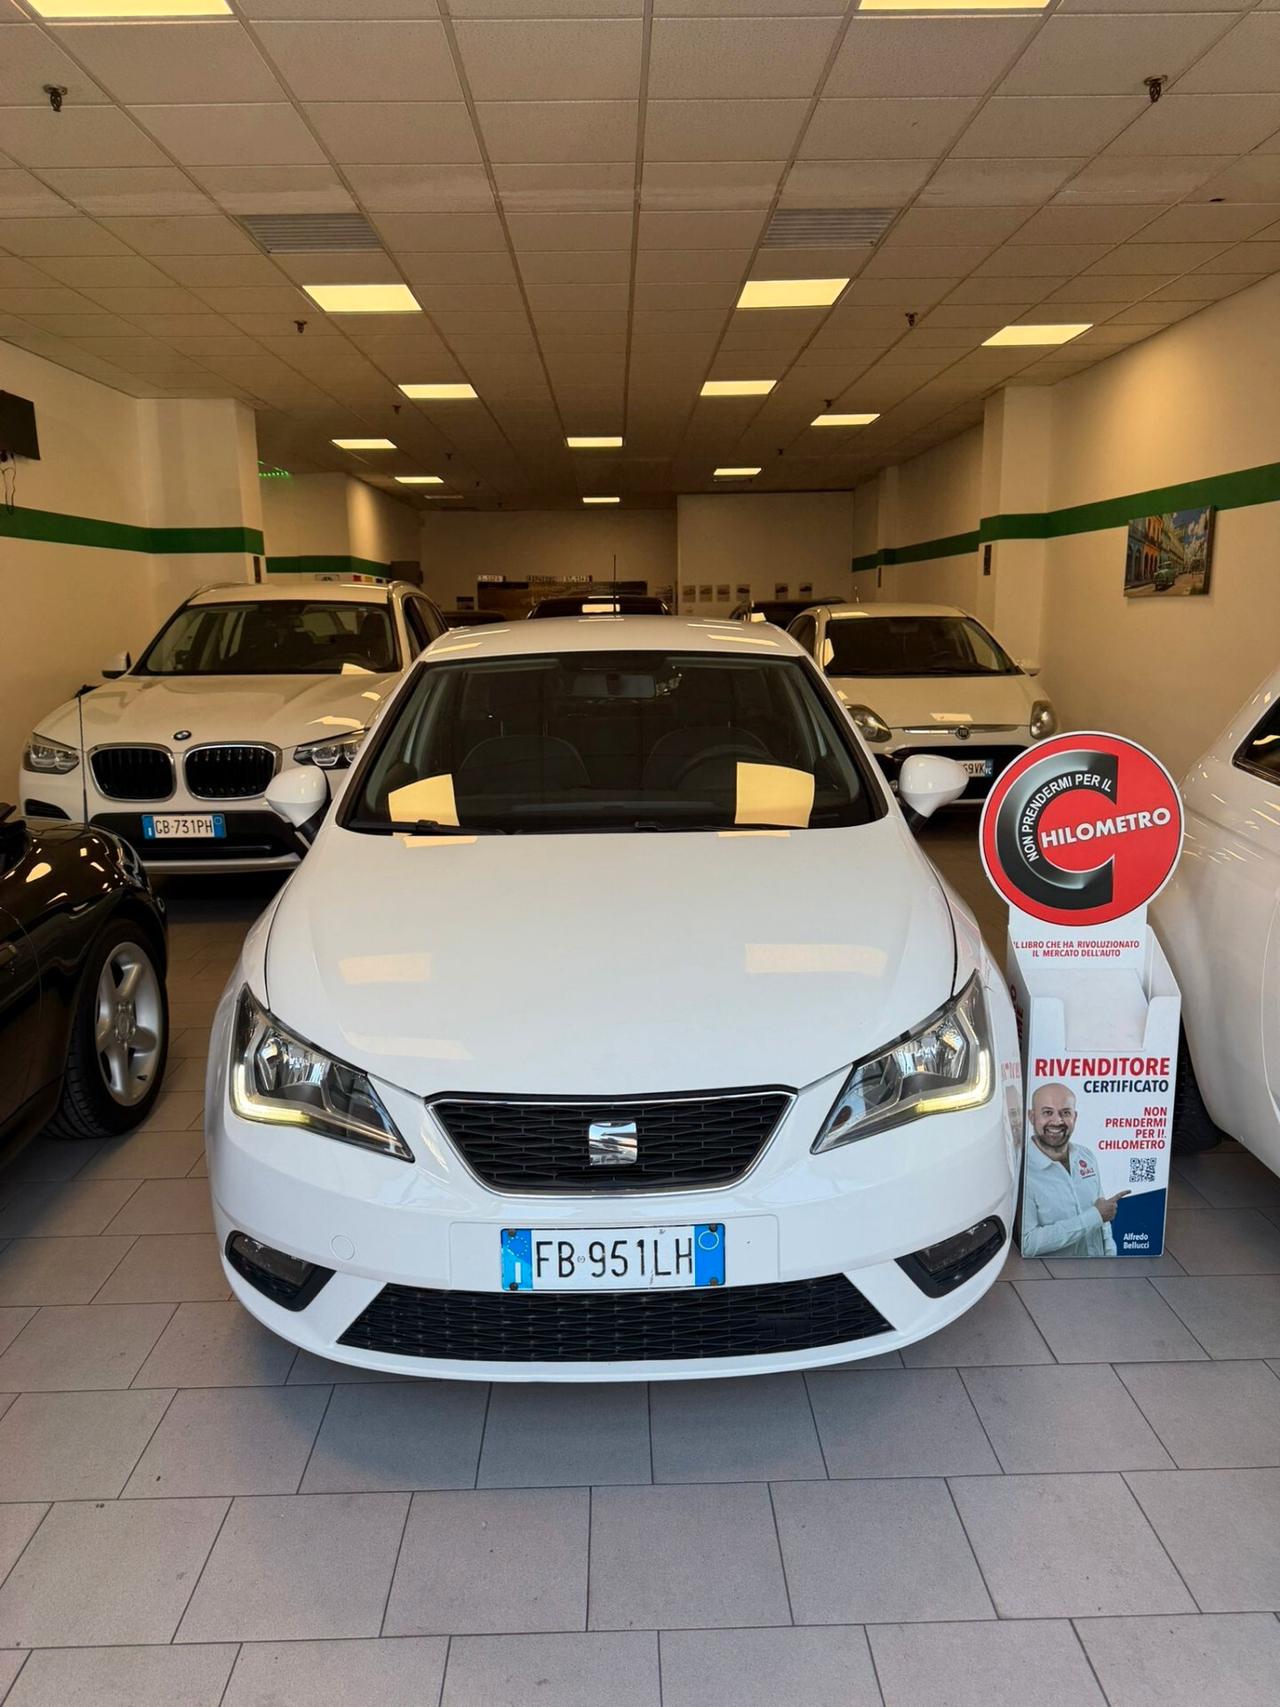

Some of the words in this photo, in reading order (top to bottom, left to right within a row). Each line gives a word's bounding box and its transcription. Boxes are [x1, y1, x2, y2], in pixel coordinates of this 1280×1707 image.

[1075, 774, 1101, 787] PER
[1101, 778, 1113, 792] IL
[1022, 775, 1073, 832] PRENDERMI
[1041, 807, 1171, 848] HILOMETRO
[1021, 836, 1039, 862] NON
[1021, 940, 1044, 949] LIBRO
[1046, 940, 1060, 948] CHE
[1062, 940, 1074, 948] HA
[1077, 940, 1140, 948] RIVOLUZIONATO
[1043, 949, 1079, 957] MERCATO
[1081, 949, 1121, 957] DELL'AUTO
[1035, 1057, 1170, 1077] RIVENDITORE
[1083, 1080, 1169, 1093] CERTIFICATO
[1143, 1107, 1168, 1116] NON
[1105, 1118, 1167, 1128] PRENDERMI
[1135, 1129, 1154, 1138] PER
[1098, 1140, 1166, 1150] CHILOMETRO
[1123, 1232, 1149, 1241] Alfredo
[1123, 1241, 1150, 1249] Bellucci
[536, 1241, 575, 1277] FB
[588, 1237, 693, 1277] 951LH
